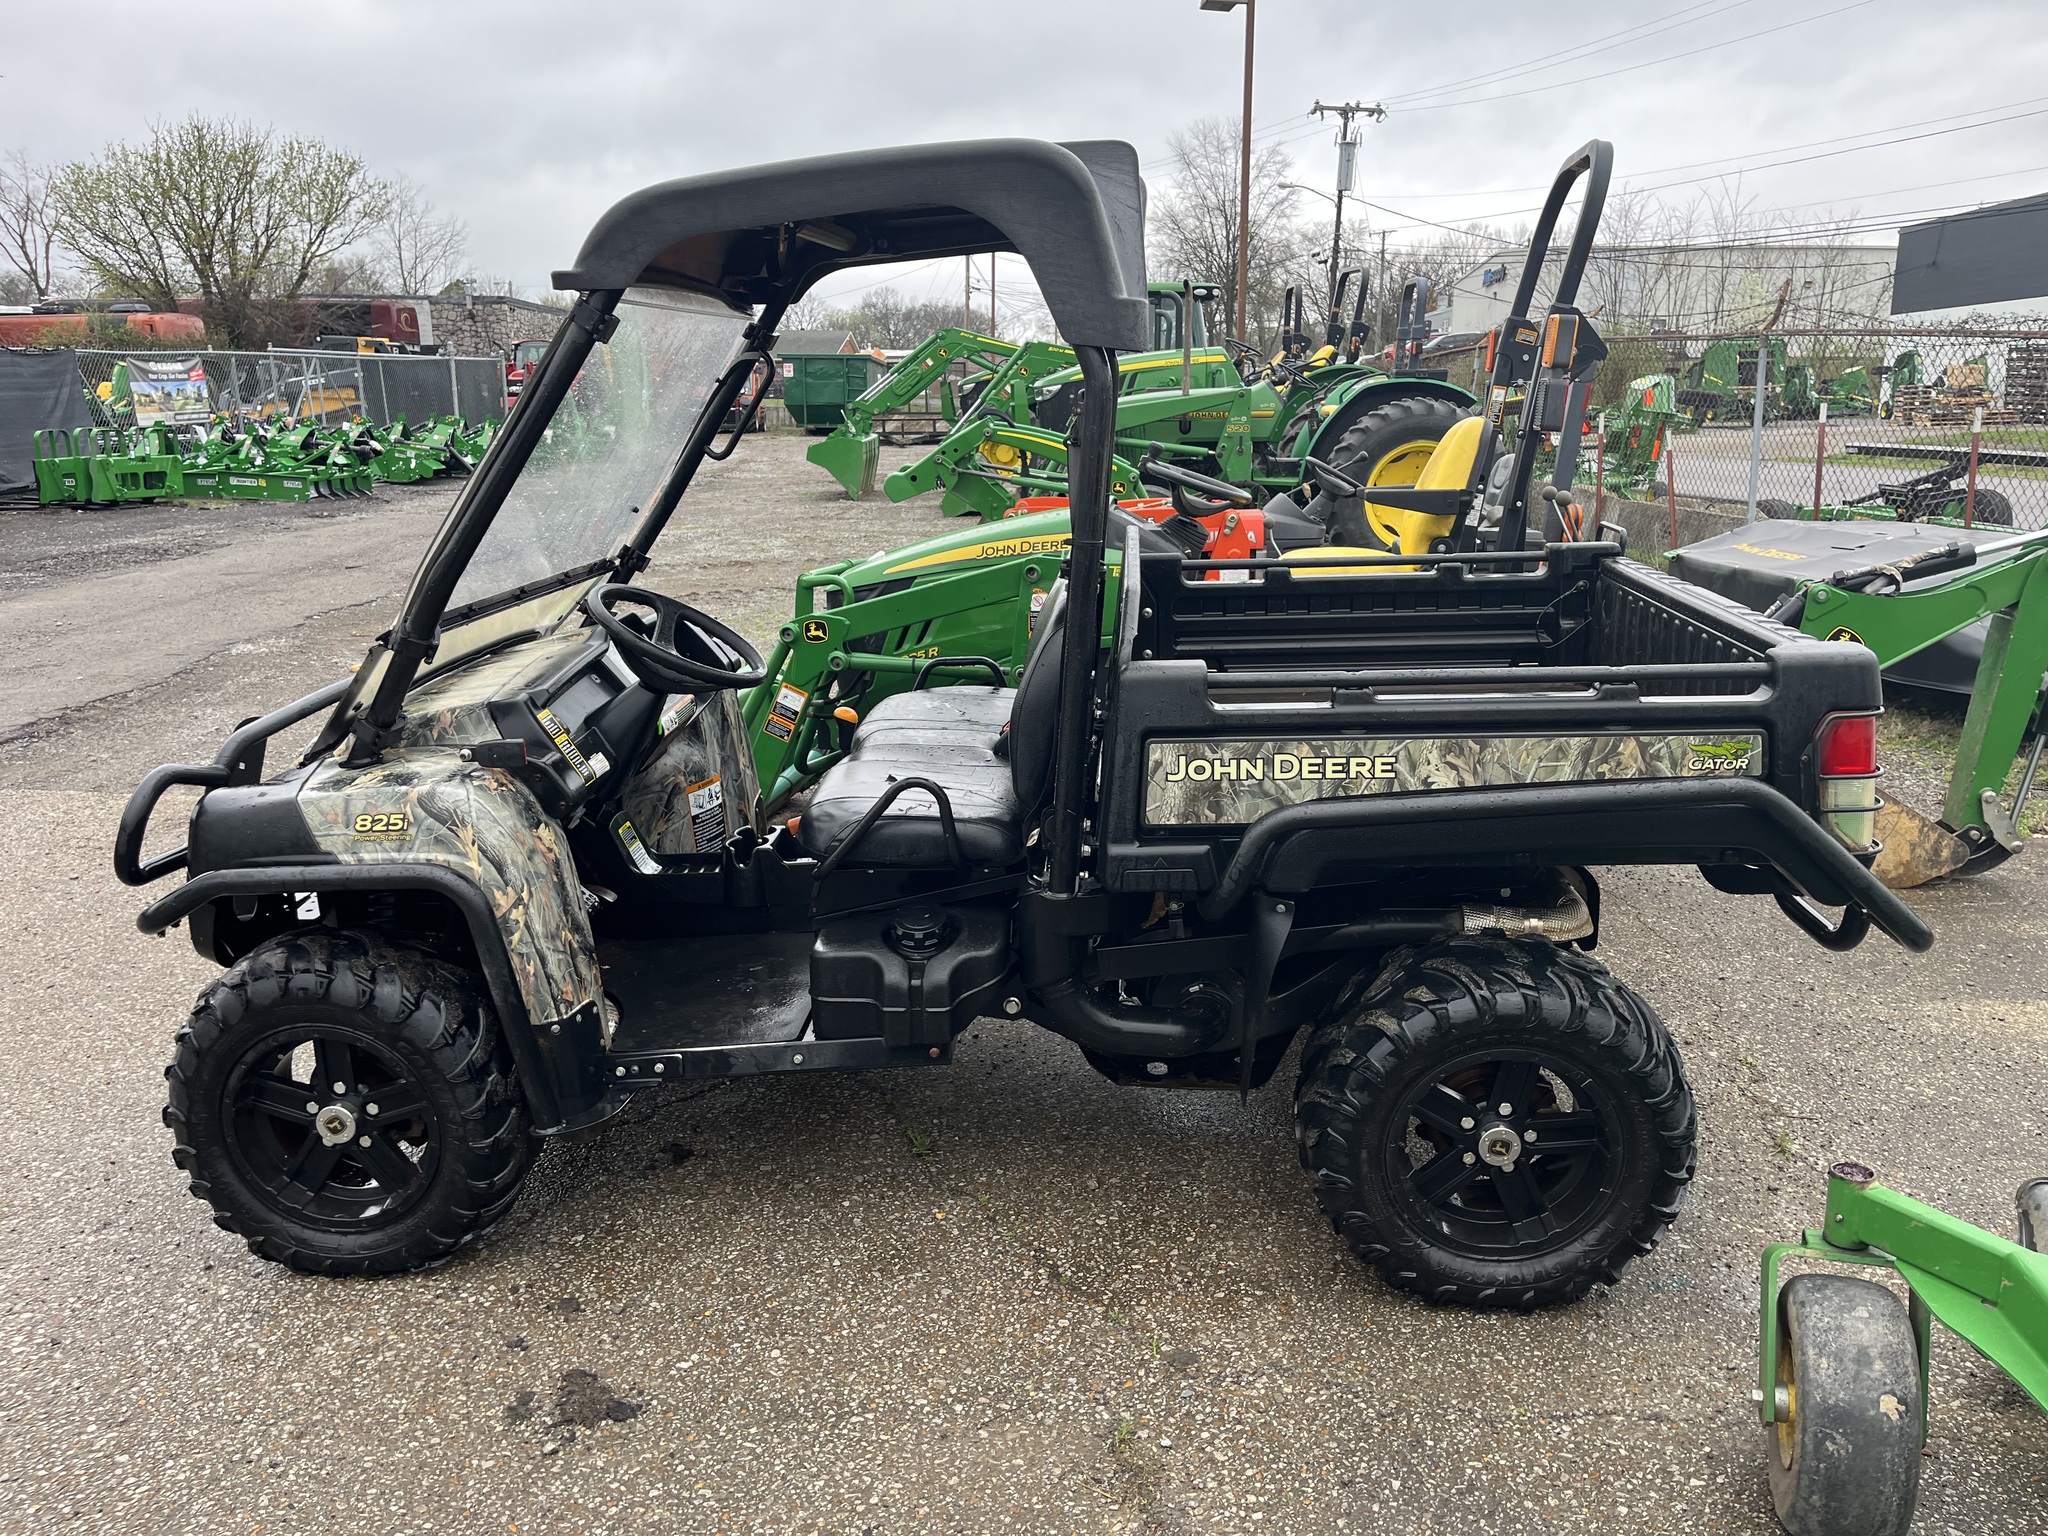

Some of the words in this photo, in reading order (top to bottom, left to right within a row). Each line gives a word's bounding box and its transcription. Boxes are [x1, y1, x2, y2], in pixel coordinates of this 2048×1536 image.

[157, 362, 184, 370] KRONE
[1227, 424, 1250, 432] 520
[976, 542, 1018, 559] JOHN
[1166, 754, 1265, 782] JOHN
[1273, 753, 1398, 780] DEERE
[1688, 757, 1749, 770] GATOR
[354, 812, 409, 833] 825i
